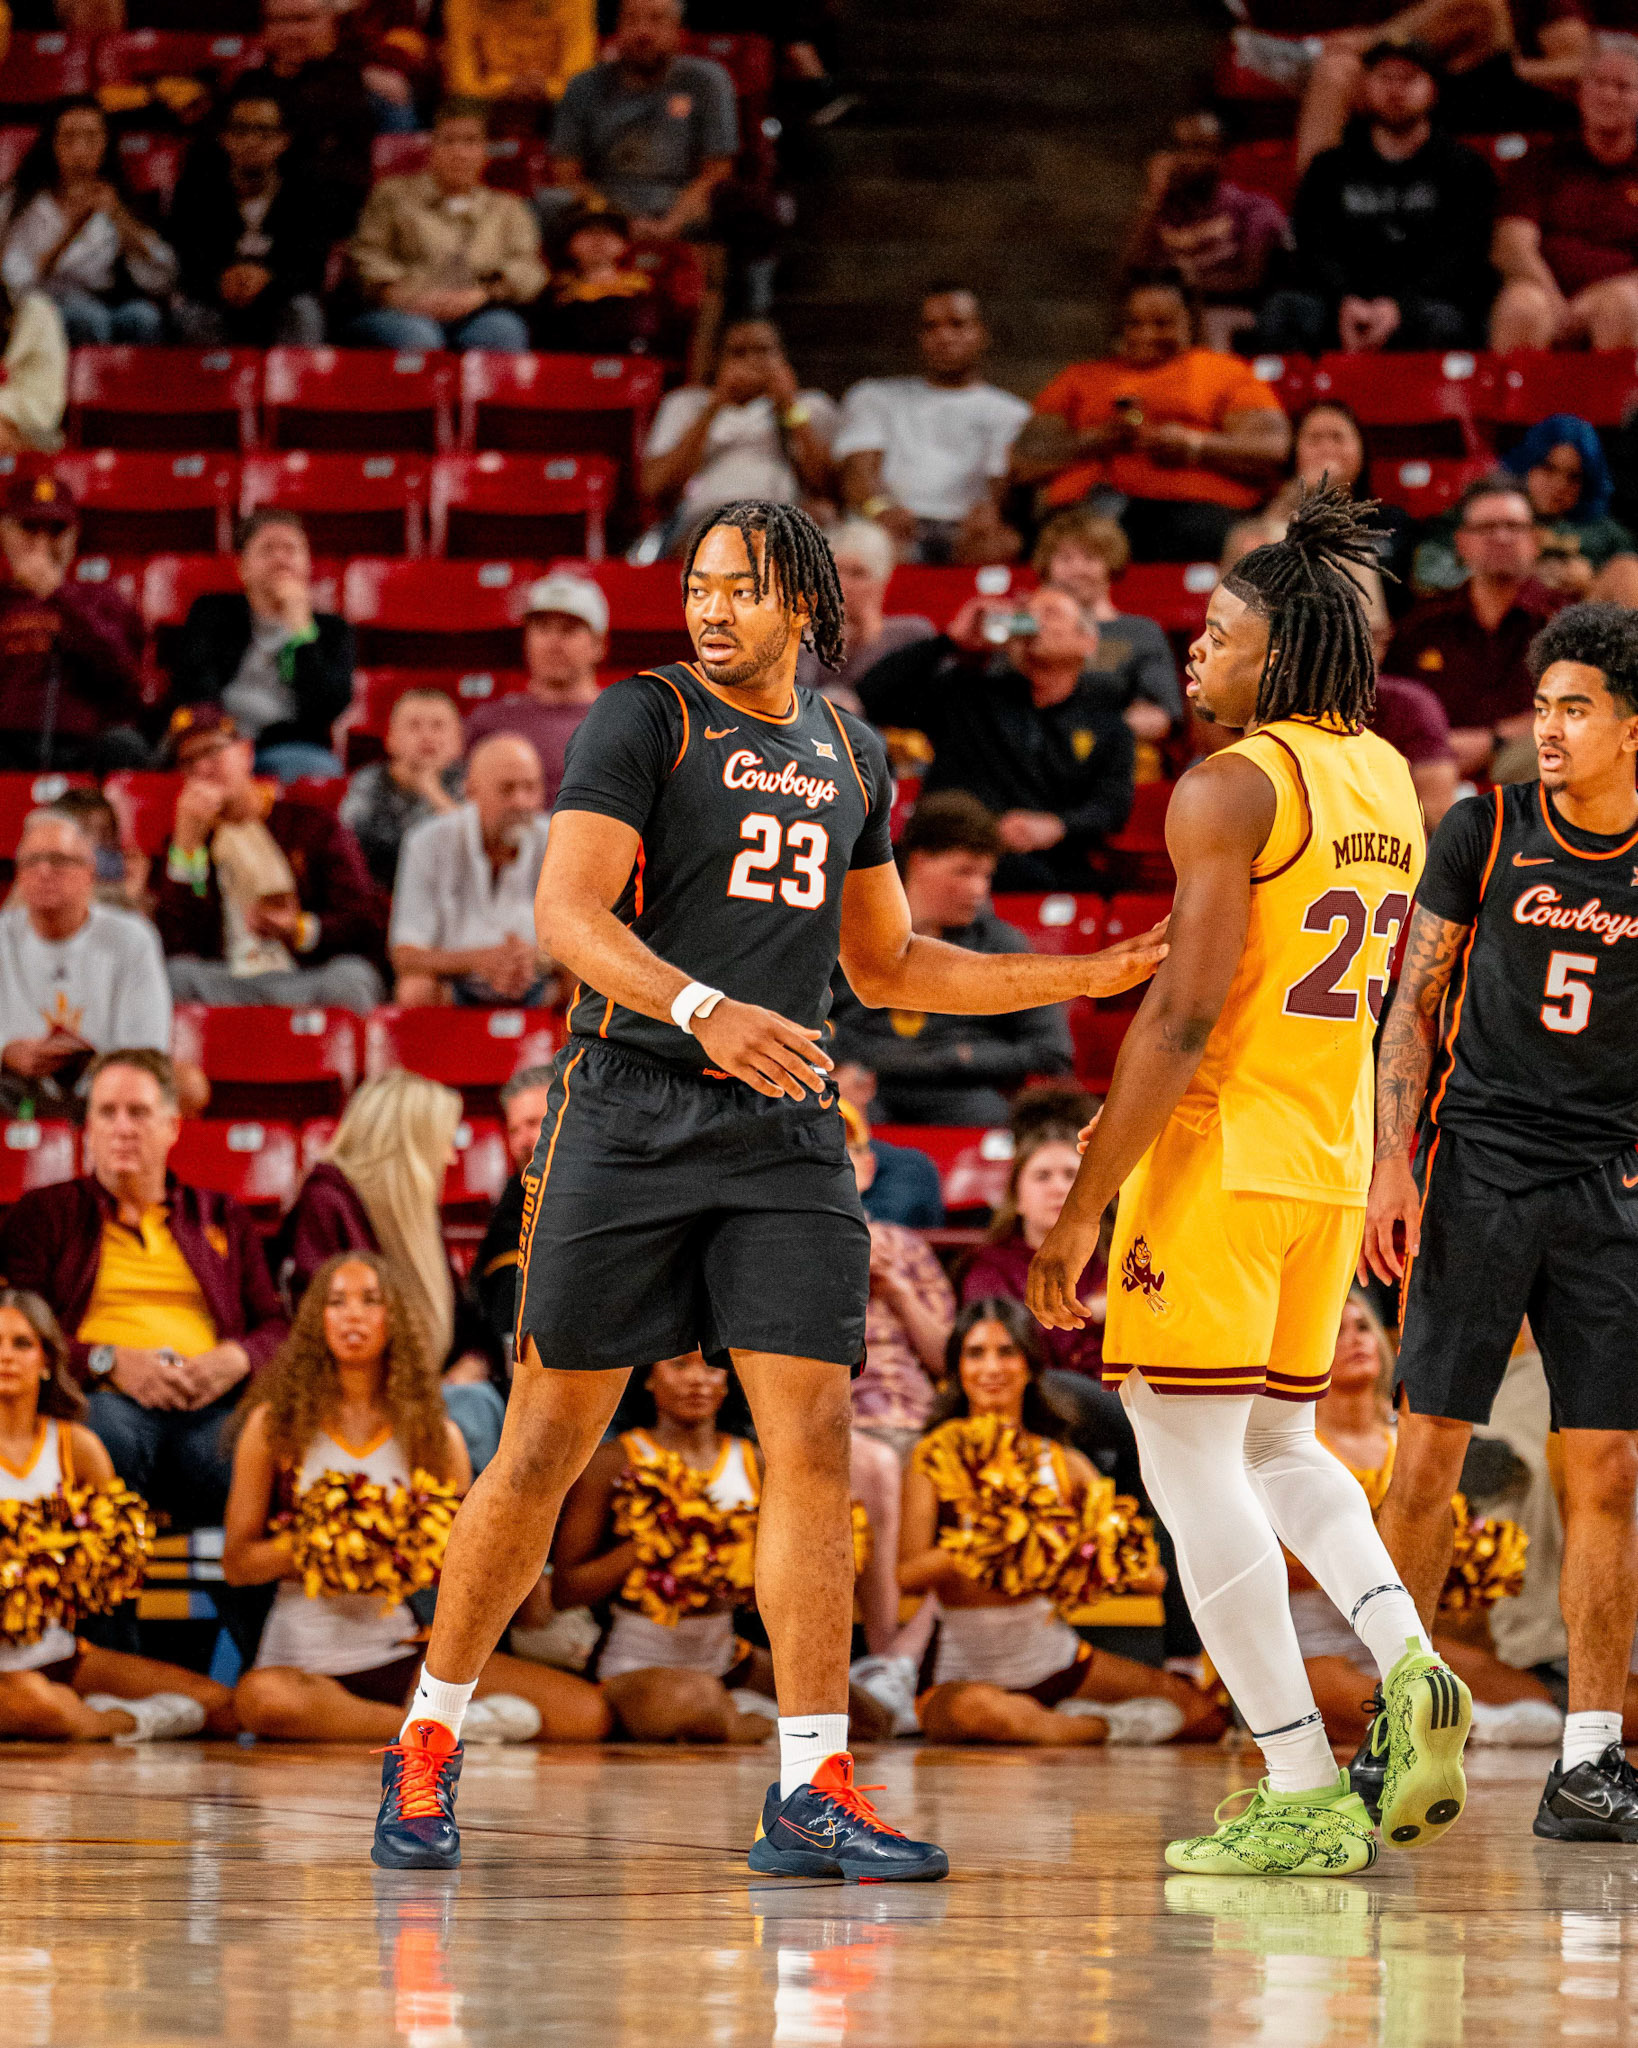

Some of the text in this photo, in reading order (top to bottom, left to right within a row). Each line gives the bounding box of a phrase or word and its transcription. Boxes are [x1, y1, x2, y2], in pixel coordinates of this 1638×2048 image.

[722, 749, 839, 808] Cowboys
[727, 812, 829, 910] 23
[1332, 833, 1412, 874] MUKEBA
[1540, 950, 1598, 1034] 5
